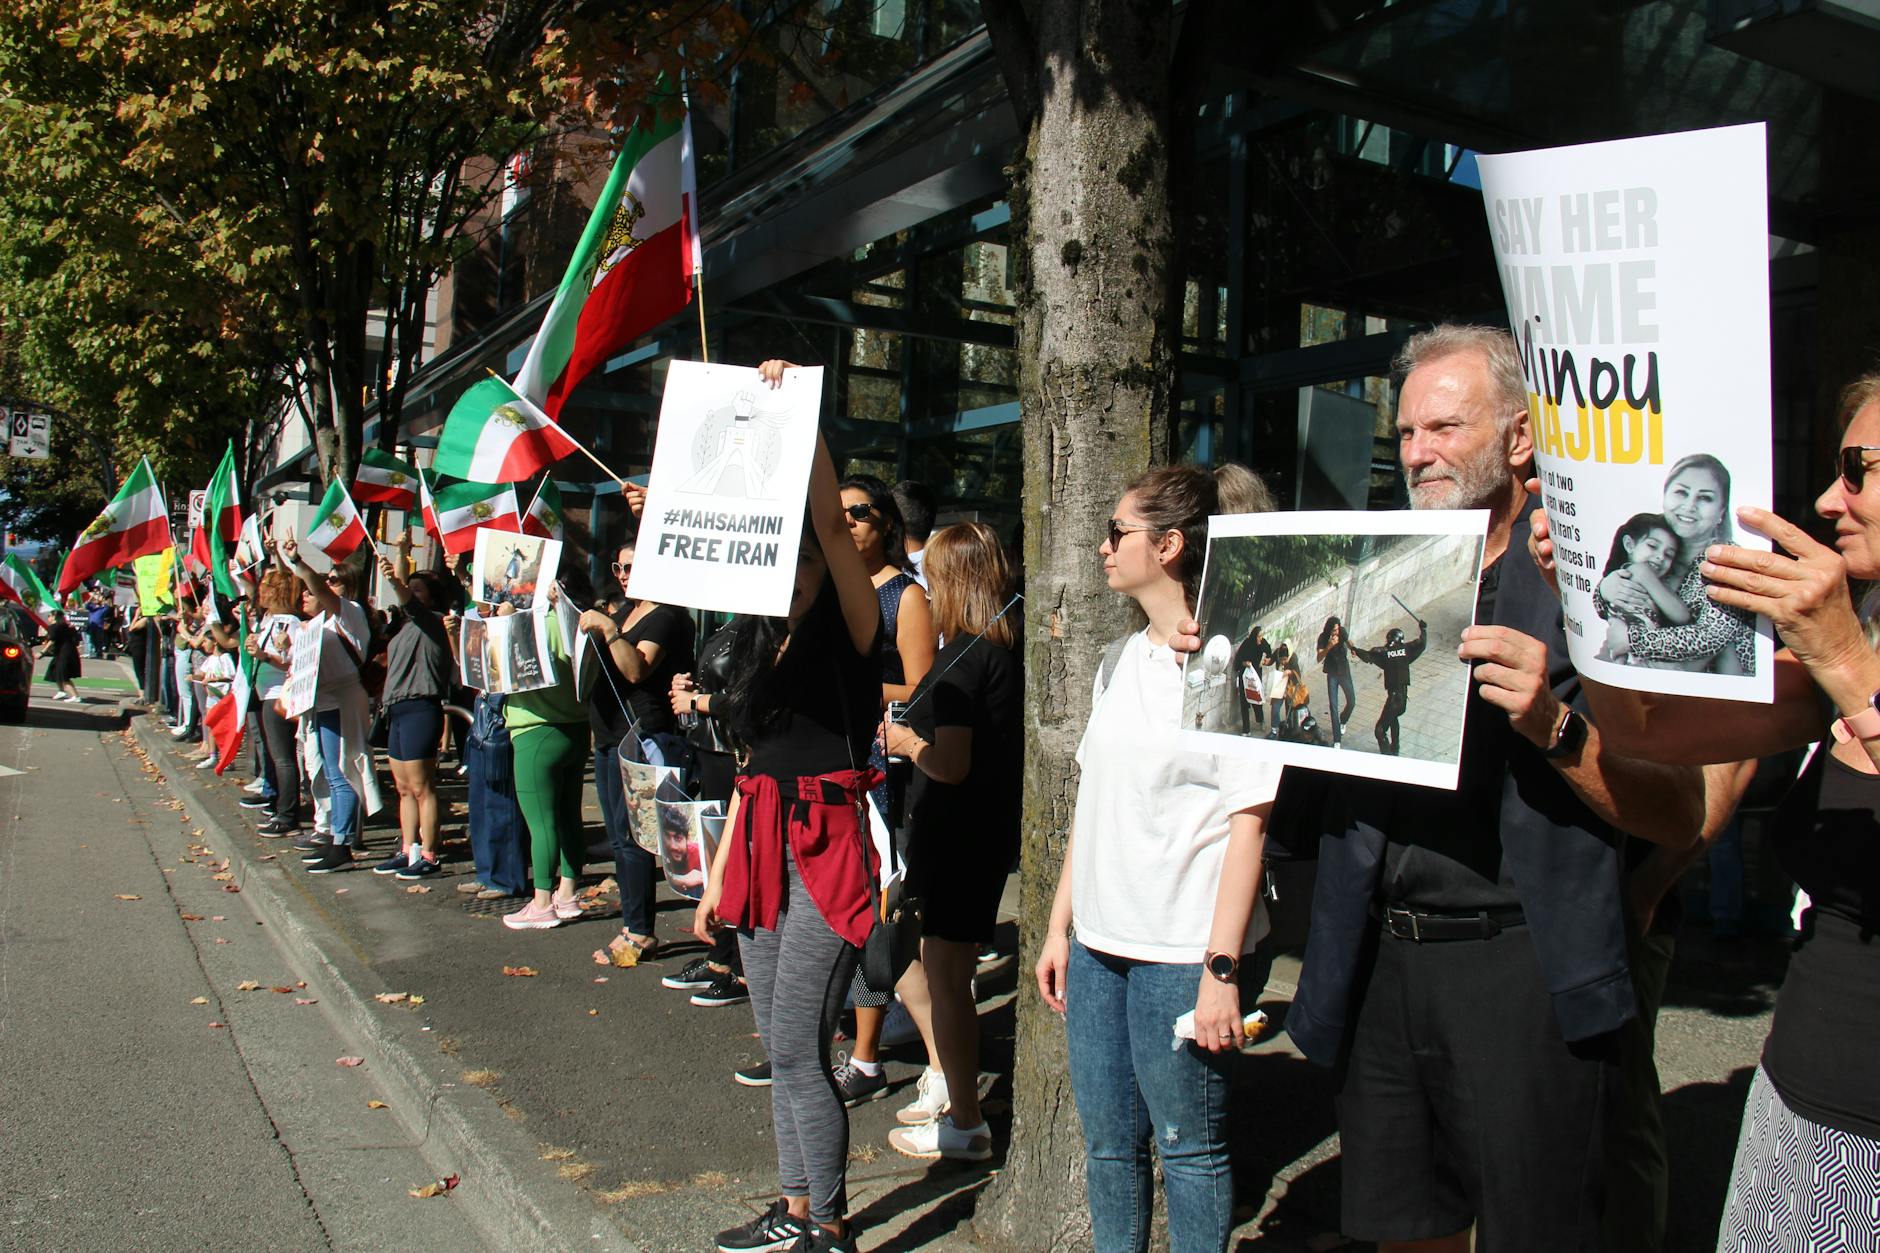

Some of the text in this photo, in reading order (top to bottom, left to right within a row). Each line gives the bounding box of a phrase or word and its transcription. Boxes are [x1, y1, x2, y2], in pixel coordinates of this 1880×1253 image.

[1495, 186, 1659, 255] SAY HER
[1503, 260, 1660, 345] NAME
[1556, 473, 1574, 492] two
[1558, 499, 1577, 517] was
[663, 509, 783, 535] #MAHSAAMINI
[1557, 522, 1581, 542] Iran's
[658, 532, 779, 567] FREE IRAN
[1558, 543, 1584, 568] forces
[1585, 551, 1596, 570] in
[1575, 573, 1592, 593] the
[1386, 648, 1407, 659] POLICE
